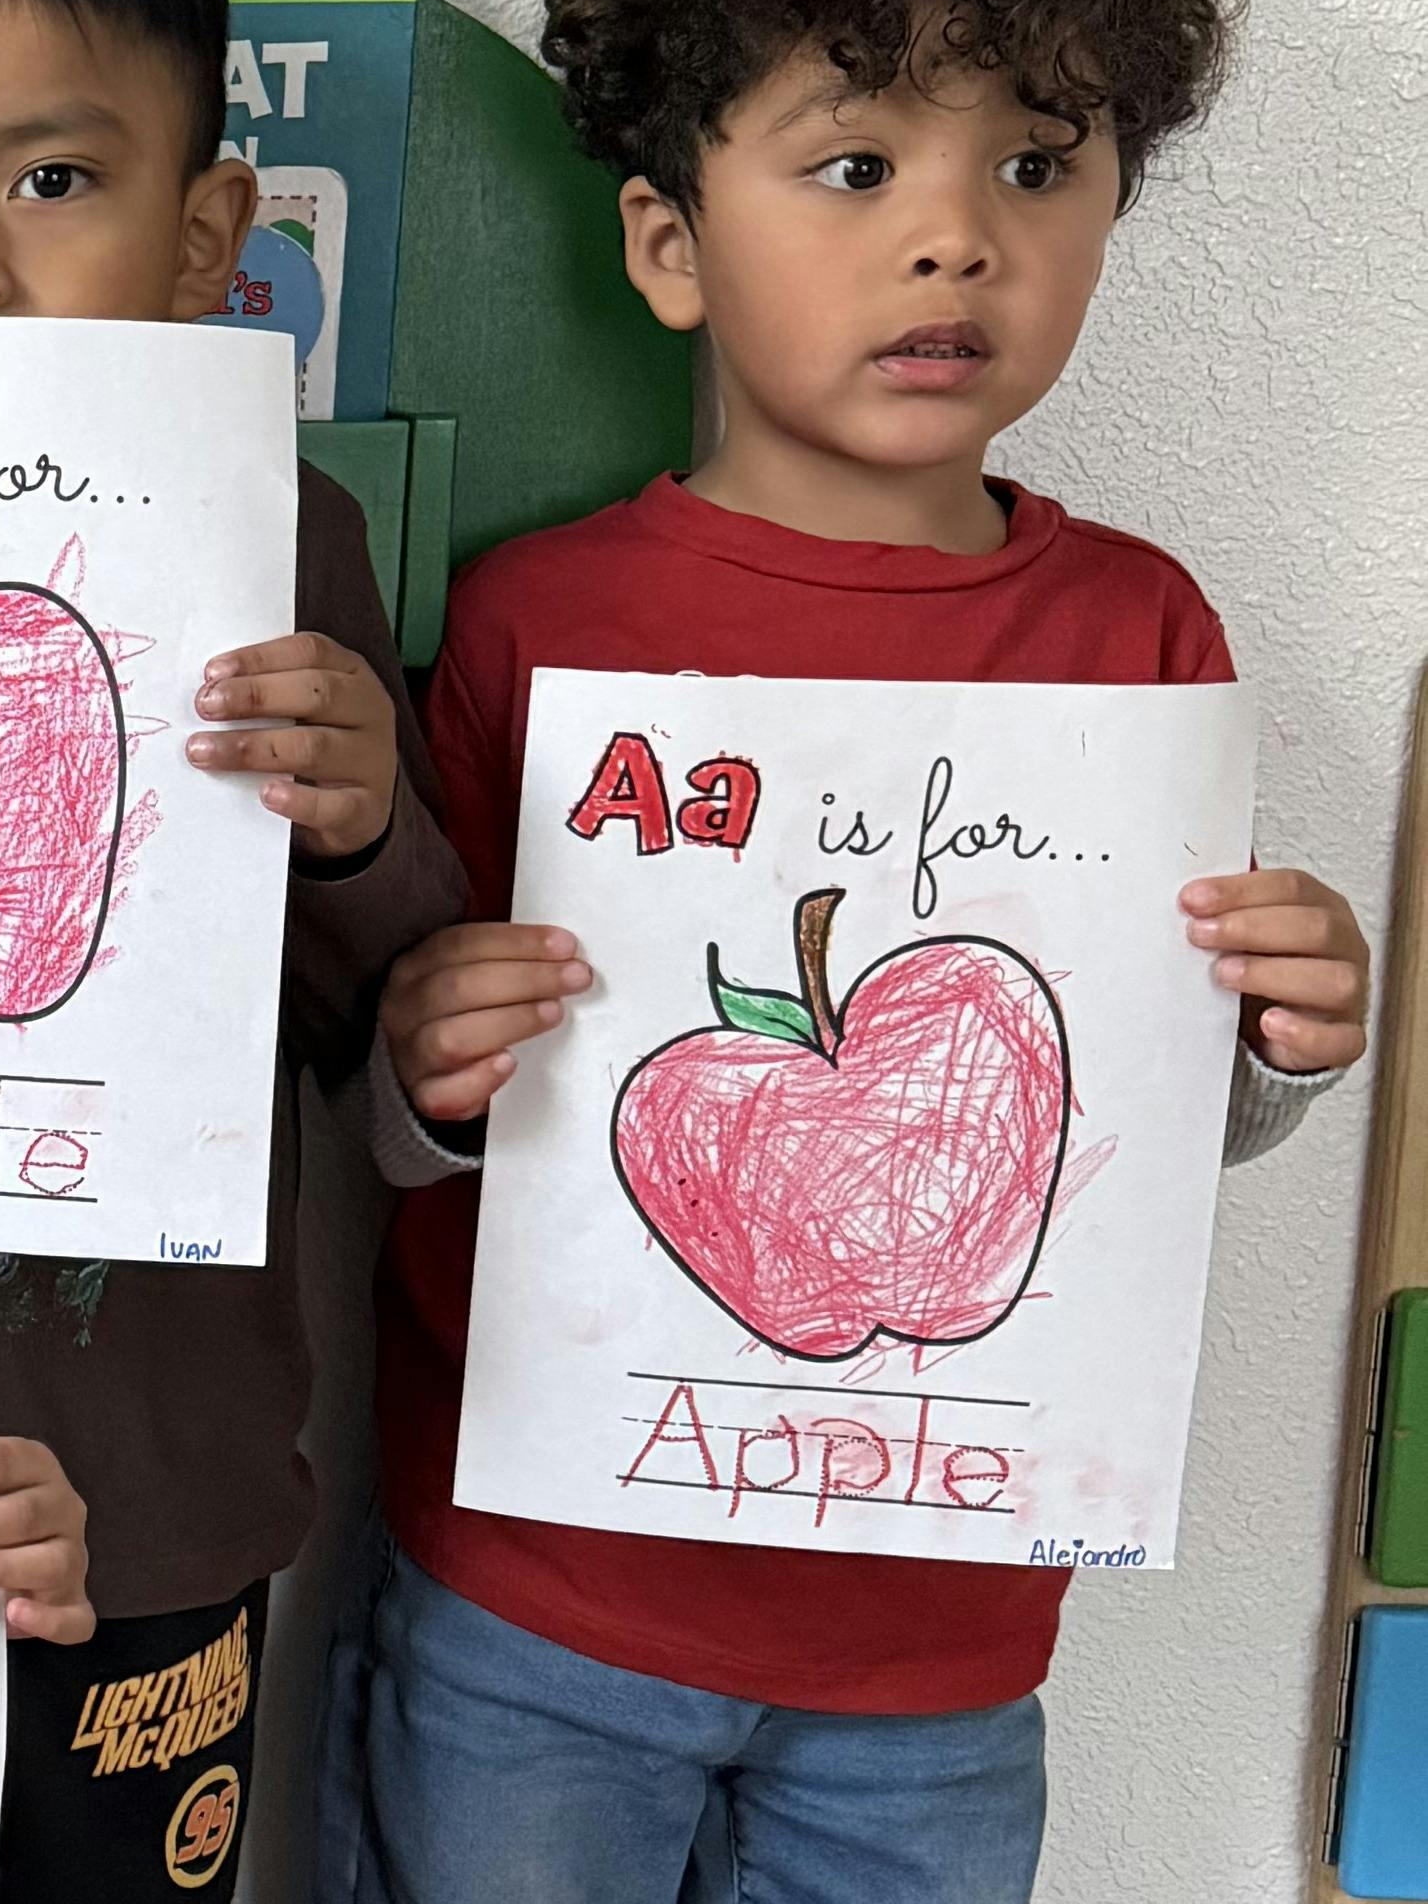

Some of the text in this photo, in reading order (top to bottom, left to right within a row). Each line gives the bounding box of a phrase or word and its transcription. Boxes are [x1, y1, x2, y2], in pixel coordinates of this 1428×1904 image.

[565, 731, 1114, 919] Aa is for...
[621, 1381, 1011, 1528] Apple
[1029, 1538, 1147, 1569] Alejandro
[70, 1606, 248, 1751] LIGHTNING
[175, 1782, 239, 1864] 95
